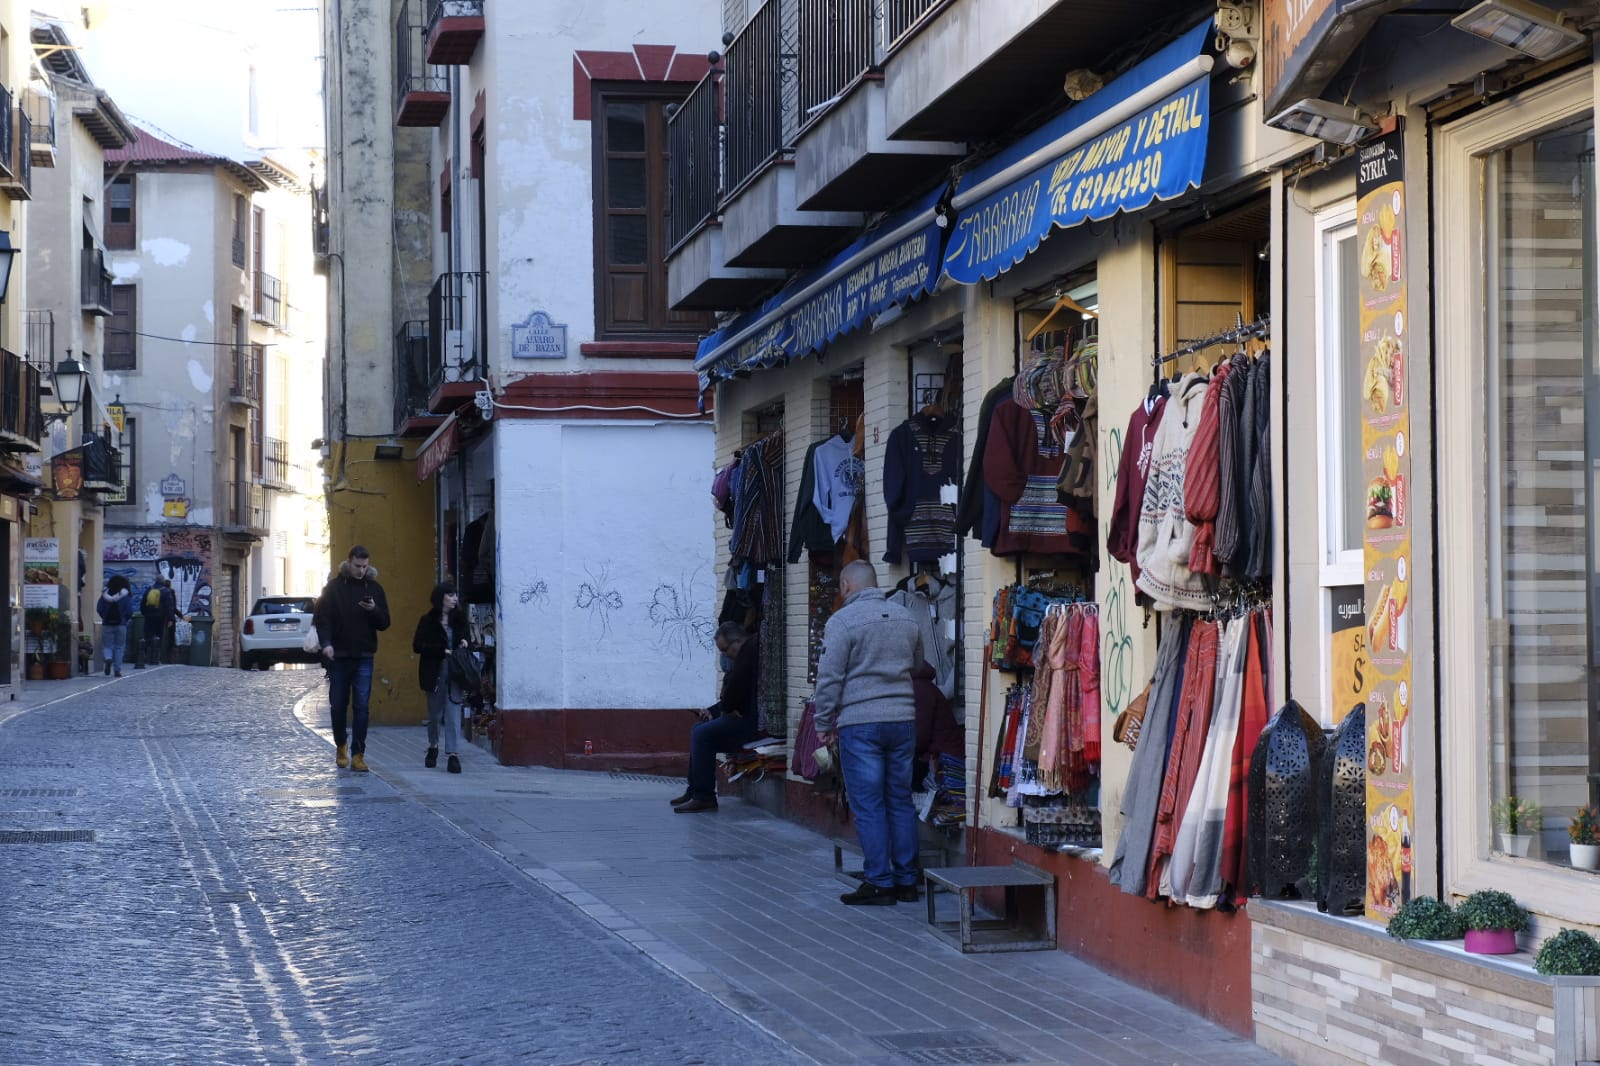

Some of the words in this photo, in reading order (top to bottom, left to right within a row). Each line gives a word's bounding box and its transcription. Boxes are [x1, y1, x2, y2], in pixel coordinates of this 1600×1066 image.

[1077, 125, 1132, 173] MAYOR
[1133, 116, 1148, 155] Y
[1360, 157, 1388, 183] SYRIA
[518, 343, 530, 352] DE
